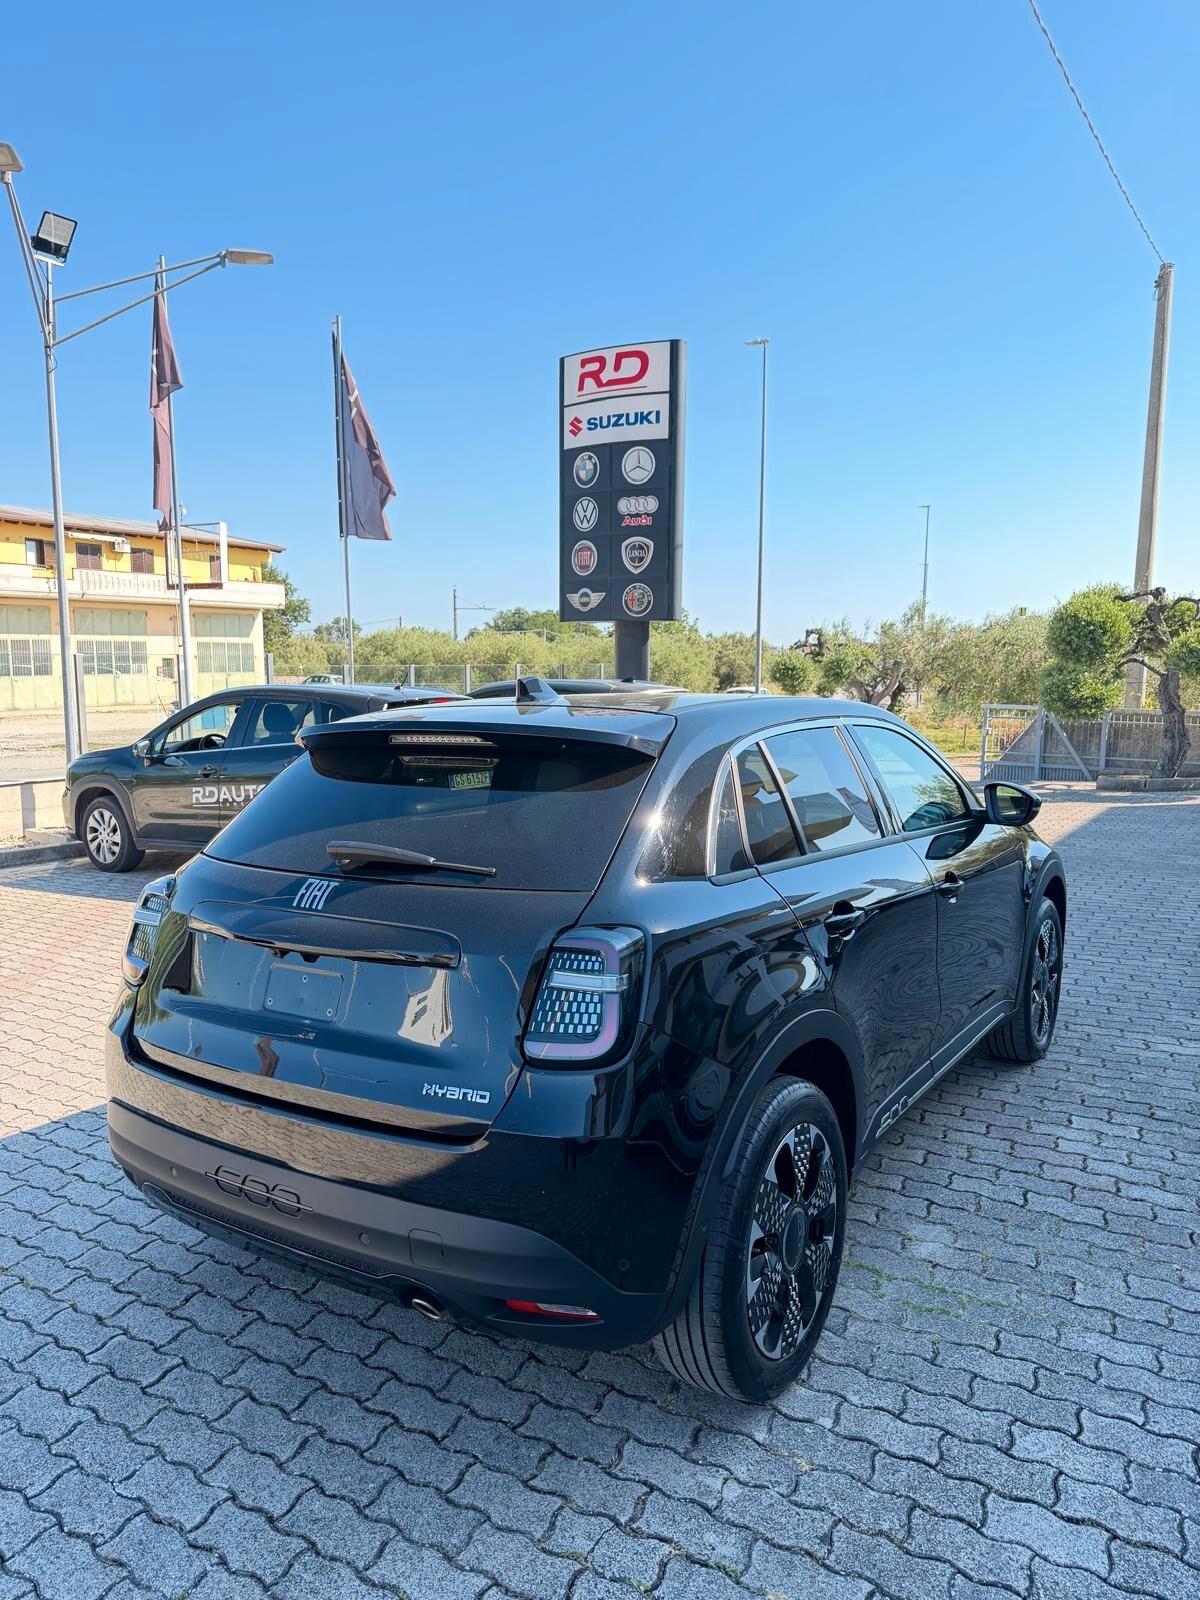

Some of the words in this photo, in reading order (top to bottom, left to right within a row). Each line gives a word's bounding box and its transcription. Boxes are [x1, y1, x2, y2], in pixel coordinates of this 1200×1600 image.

[577, 350, 649, 392] RD
[586, 410, 661, 431] SUZUKI
[578, 551, 591, 566] FIAT
[628, 549, 646, 558] LANCIA
[292, 878, 340, 910] FIAT
